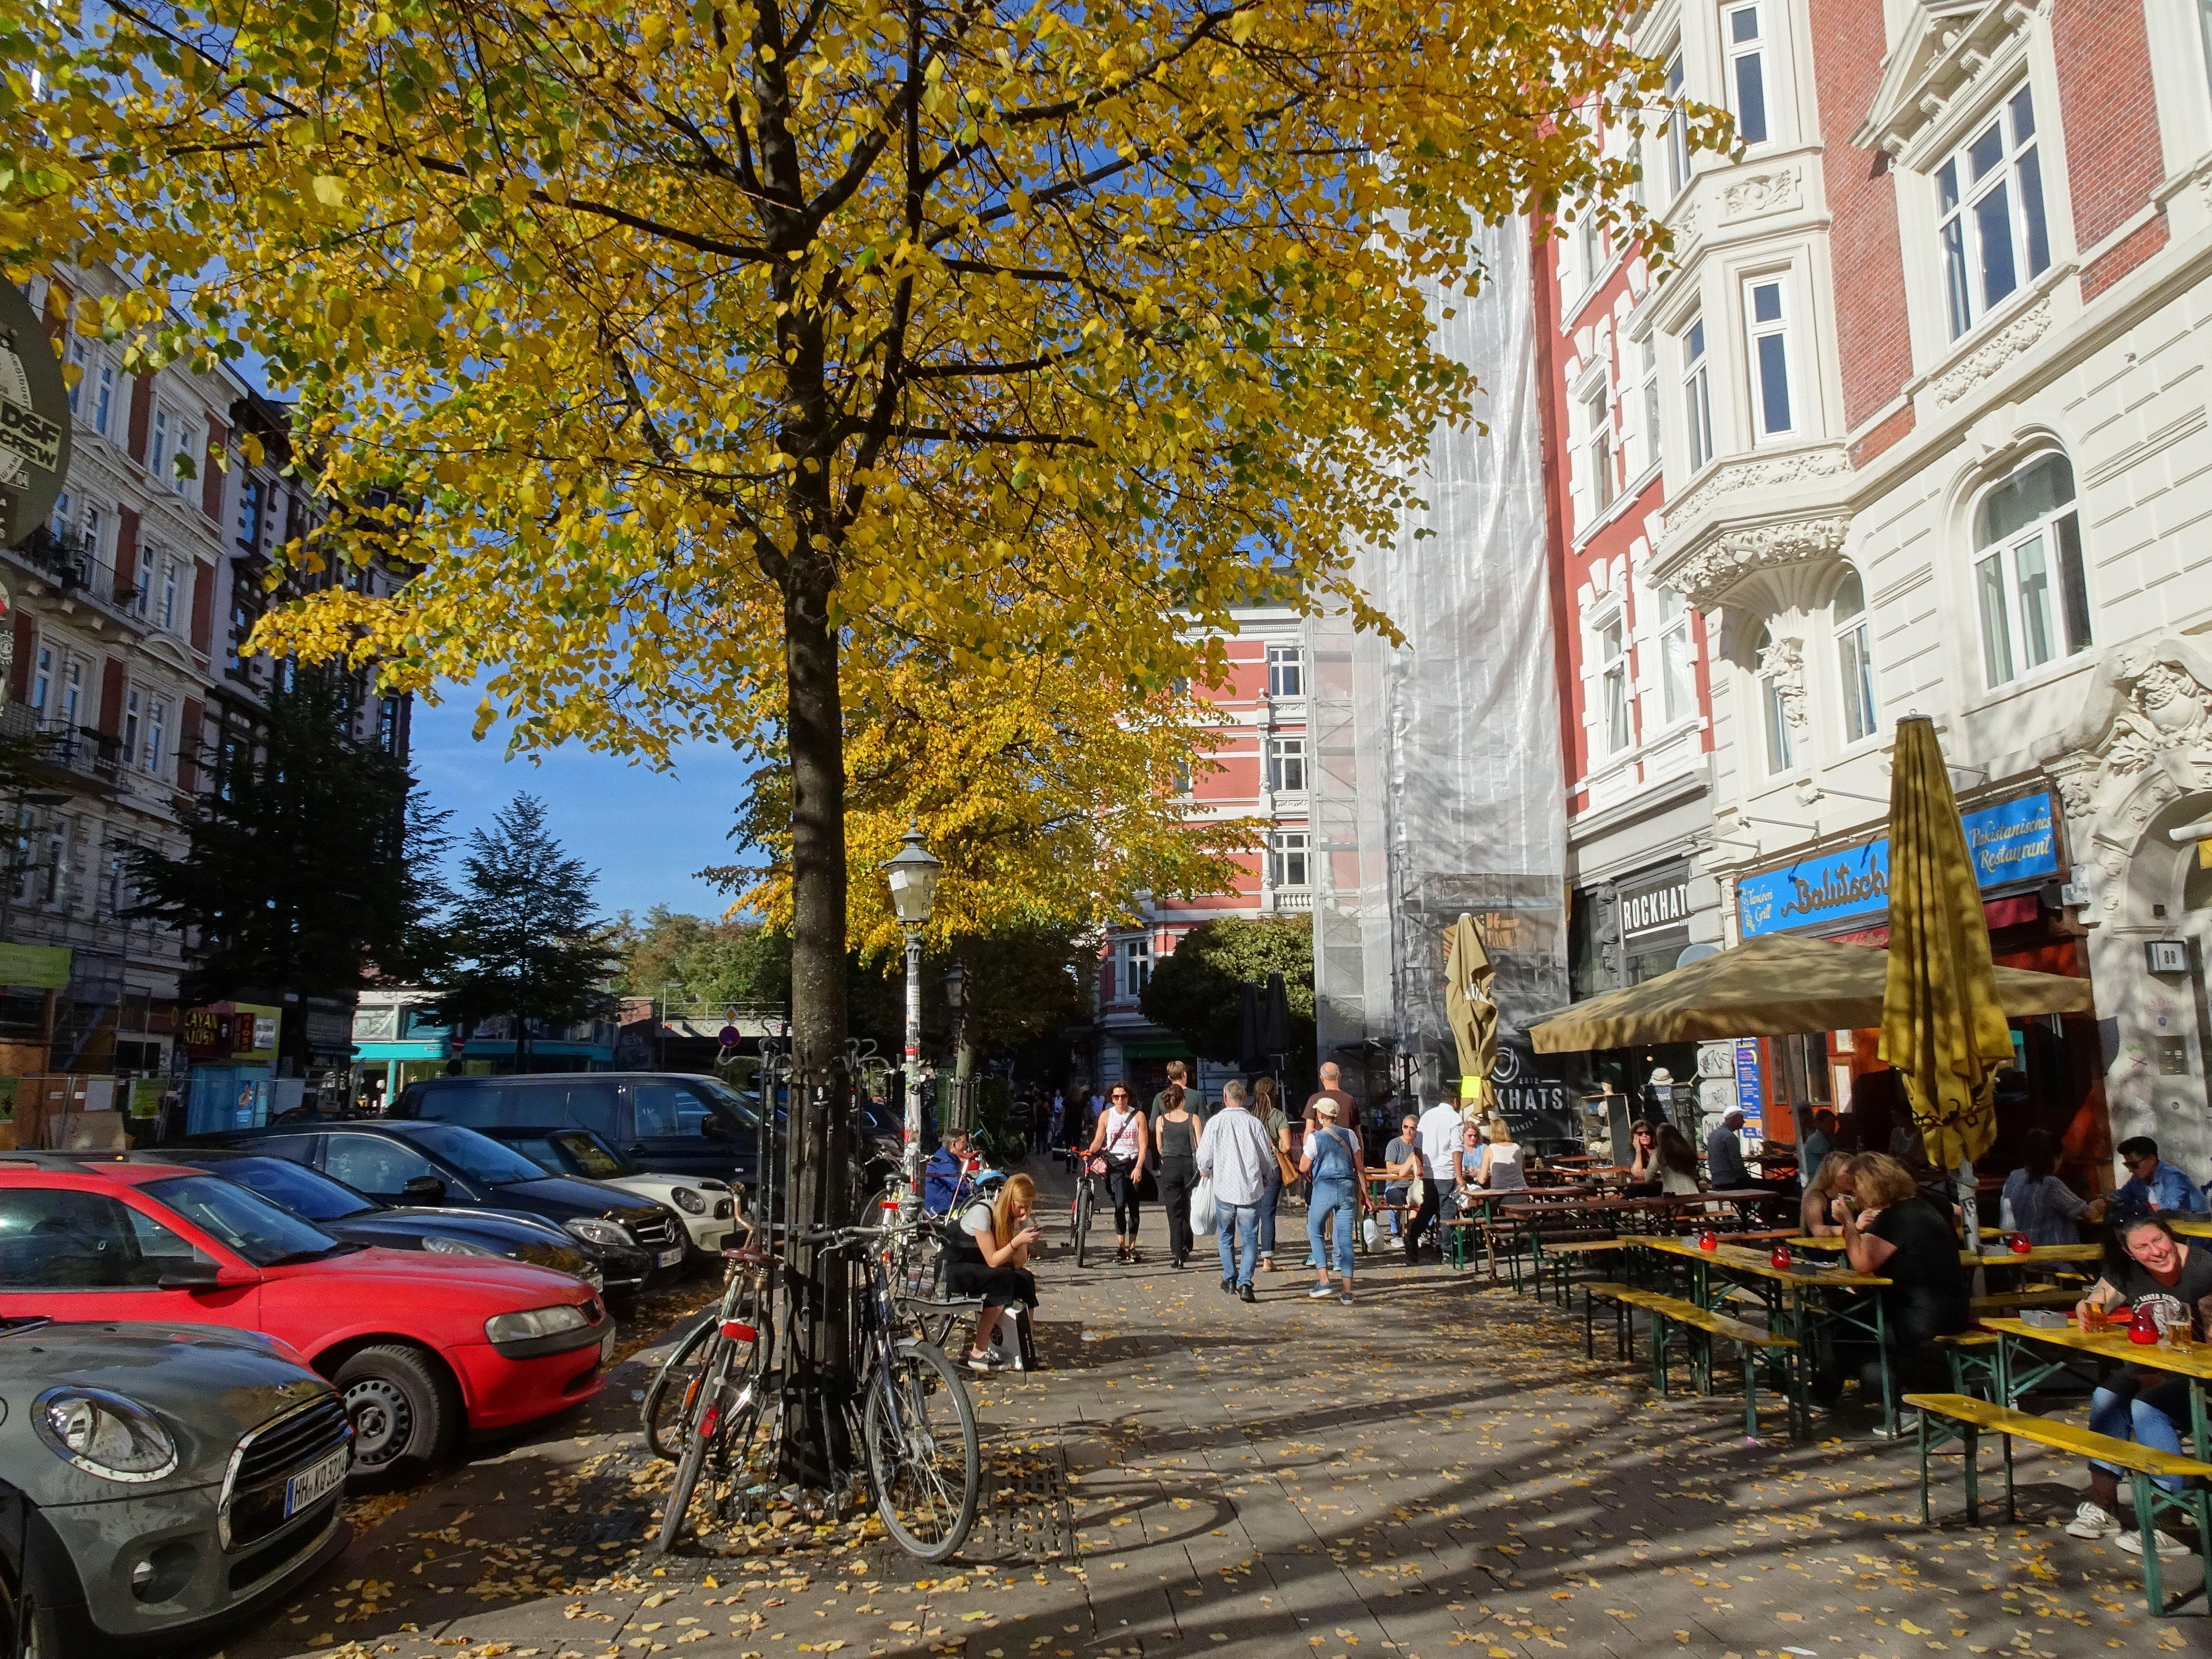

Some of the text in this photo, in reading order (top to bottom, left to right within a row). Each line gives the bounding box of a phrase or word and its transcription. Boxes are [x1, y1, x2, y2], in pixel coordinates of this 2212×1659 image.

[0, 401, 60, 445] DSF
[0, 430, 57, 467] CREW
[1969, 806, 2052, 848] Pakistanisches
[1979, 834, 2052, 873] Restaurant
[1780, 853, 1889, 918] Balutsch
[1755, 903, 1771, 927] Grill
[1494, 1088, 1563, 1110] KHATS
[294, 1475, 309, 1508] HH
